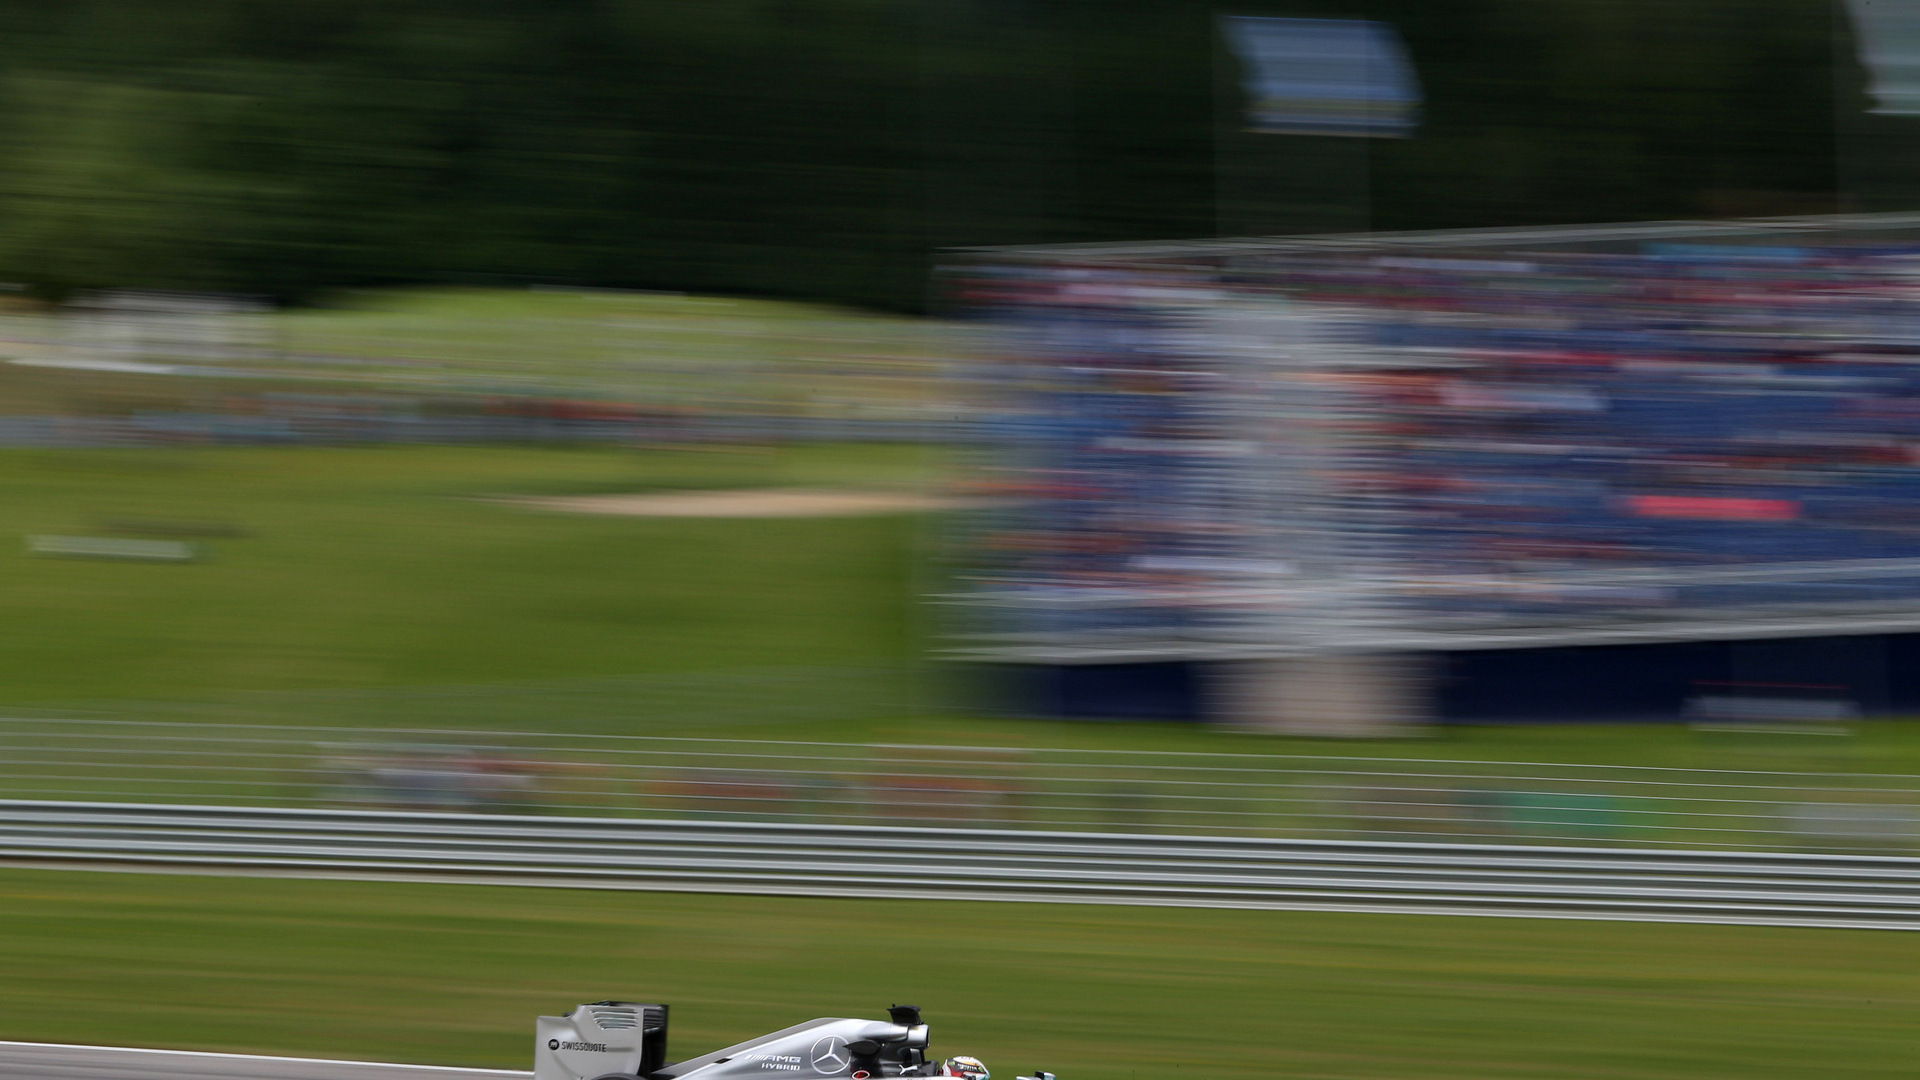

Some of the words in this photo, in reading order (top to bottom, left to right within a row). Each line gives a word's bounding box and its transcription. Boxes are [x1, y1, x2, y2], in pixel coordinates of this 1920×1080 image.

[561, 1041, 606, 1052] SWISSQUOTE
[764, 1054, 801, 1063] AMG
[761, 1062, 801, 1071] HYBRID
